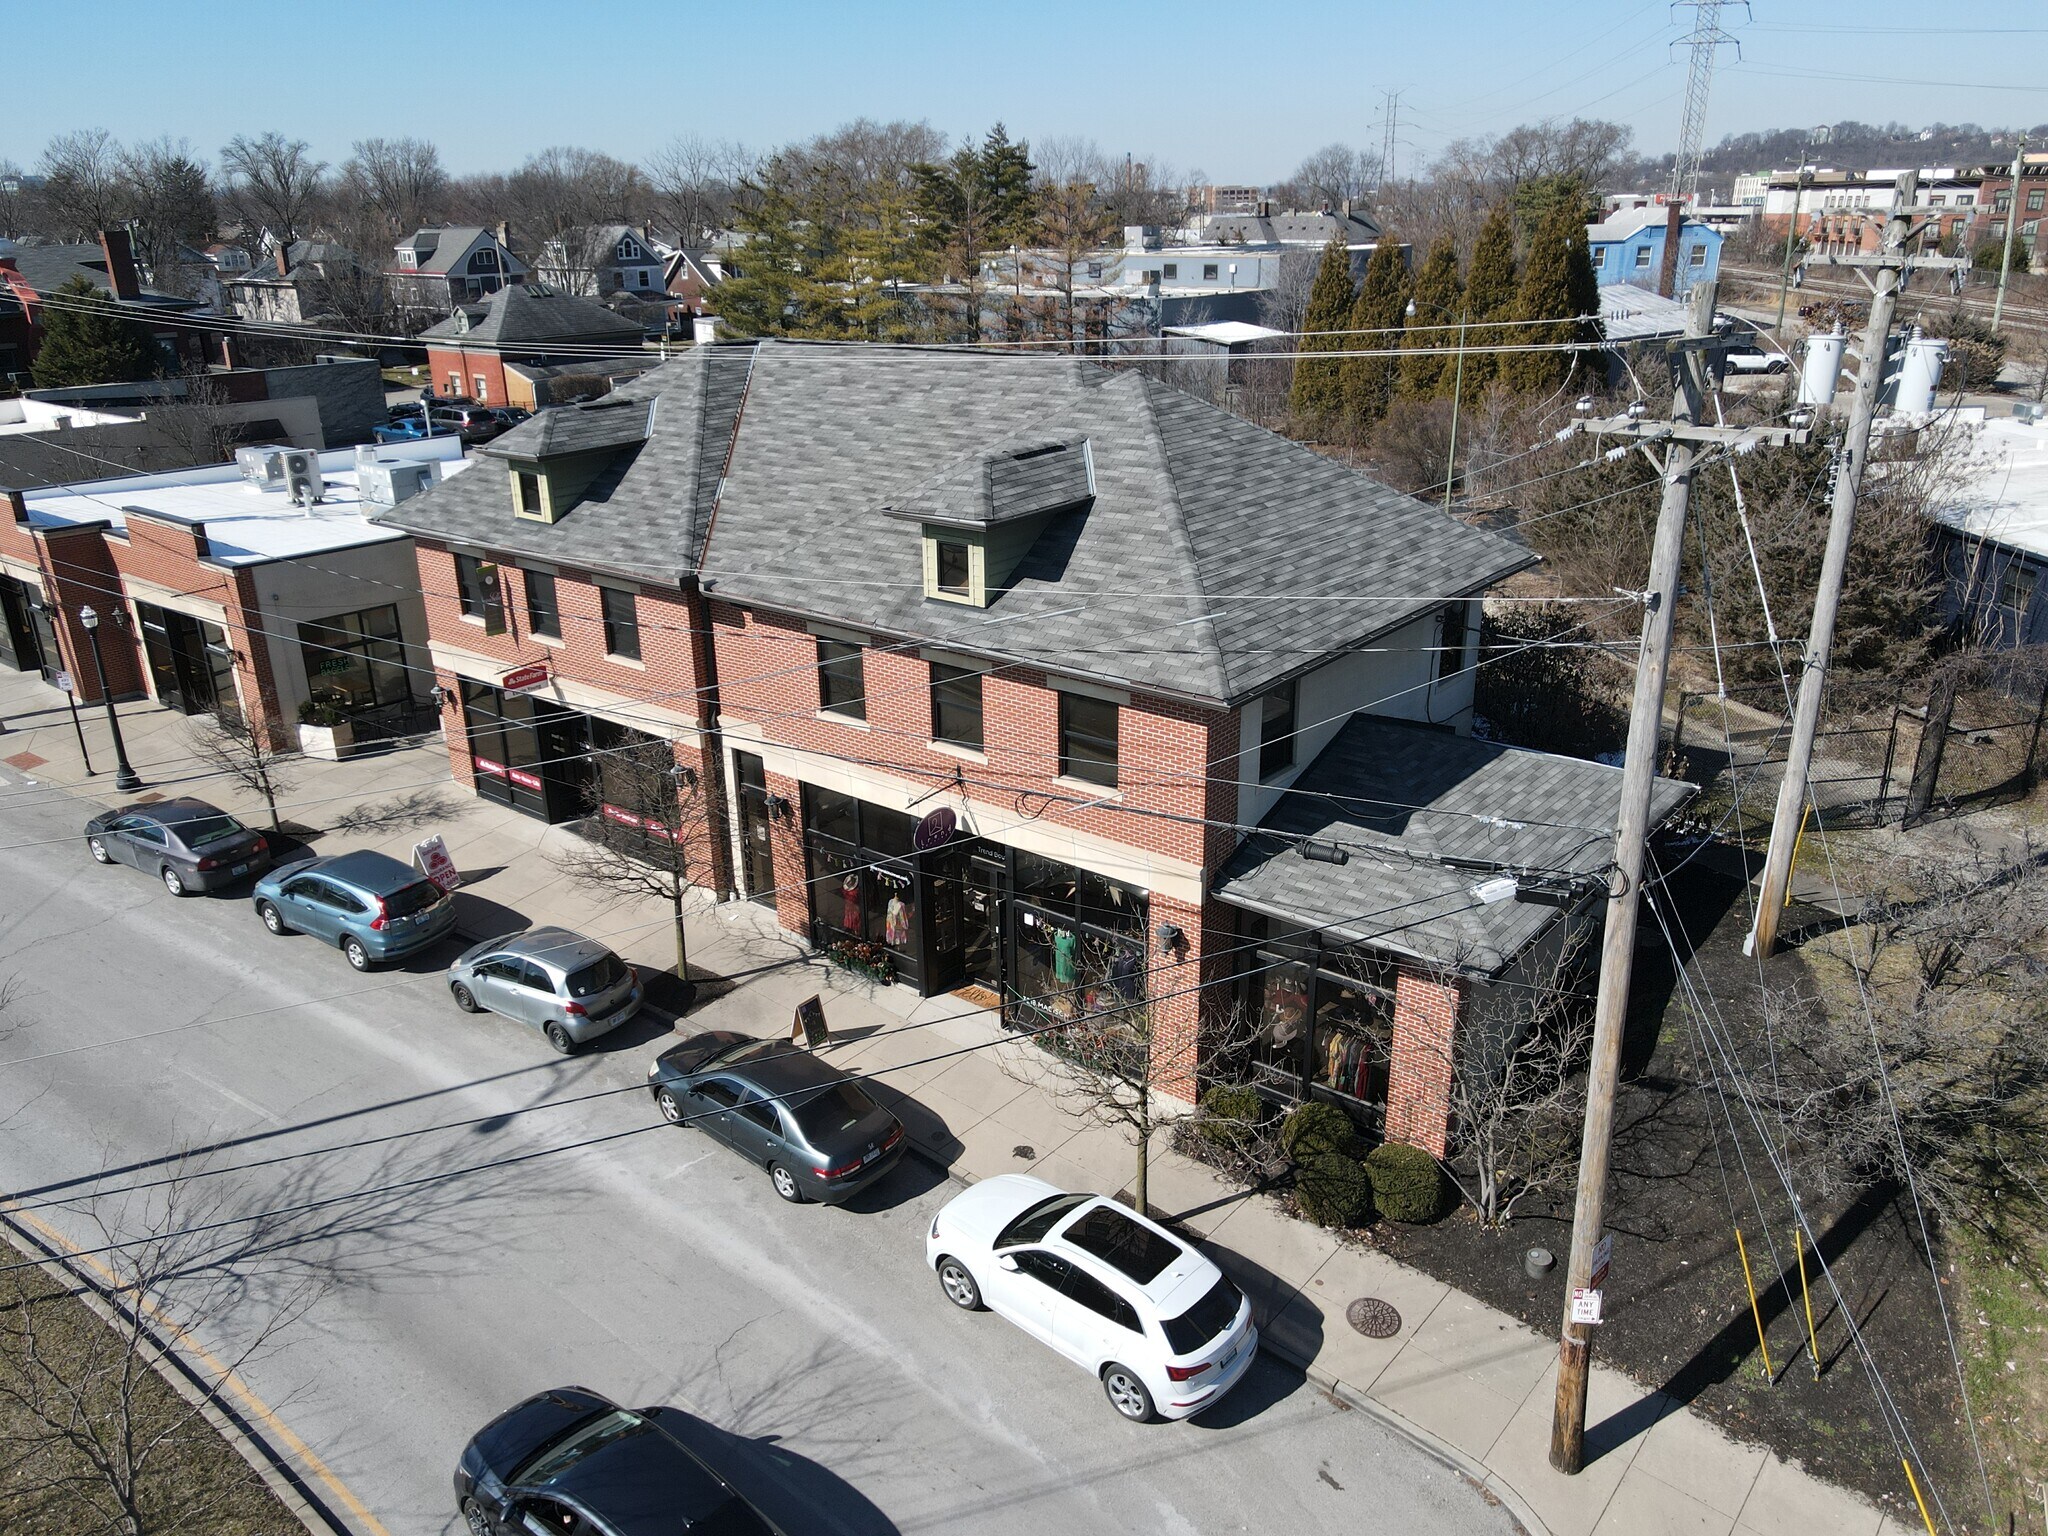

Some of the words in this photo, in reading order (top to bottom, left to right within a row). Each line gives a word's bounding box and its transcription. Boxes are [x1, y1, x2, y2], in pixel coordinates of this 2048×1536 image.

[320, 656, 350, 669] FRESH
[977, 845, 993, 857] Trend
[434, 868, 457, 883] OPEN
[1577, 1308, 1594, 1316] TIME
